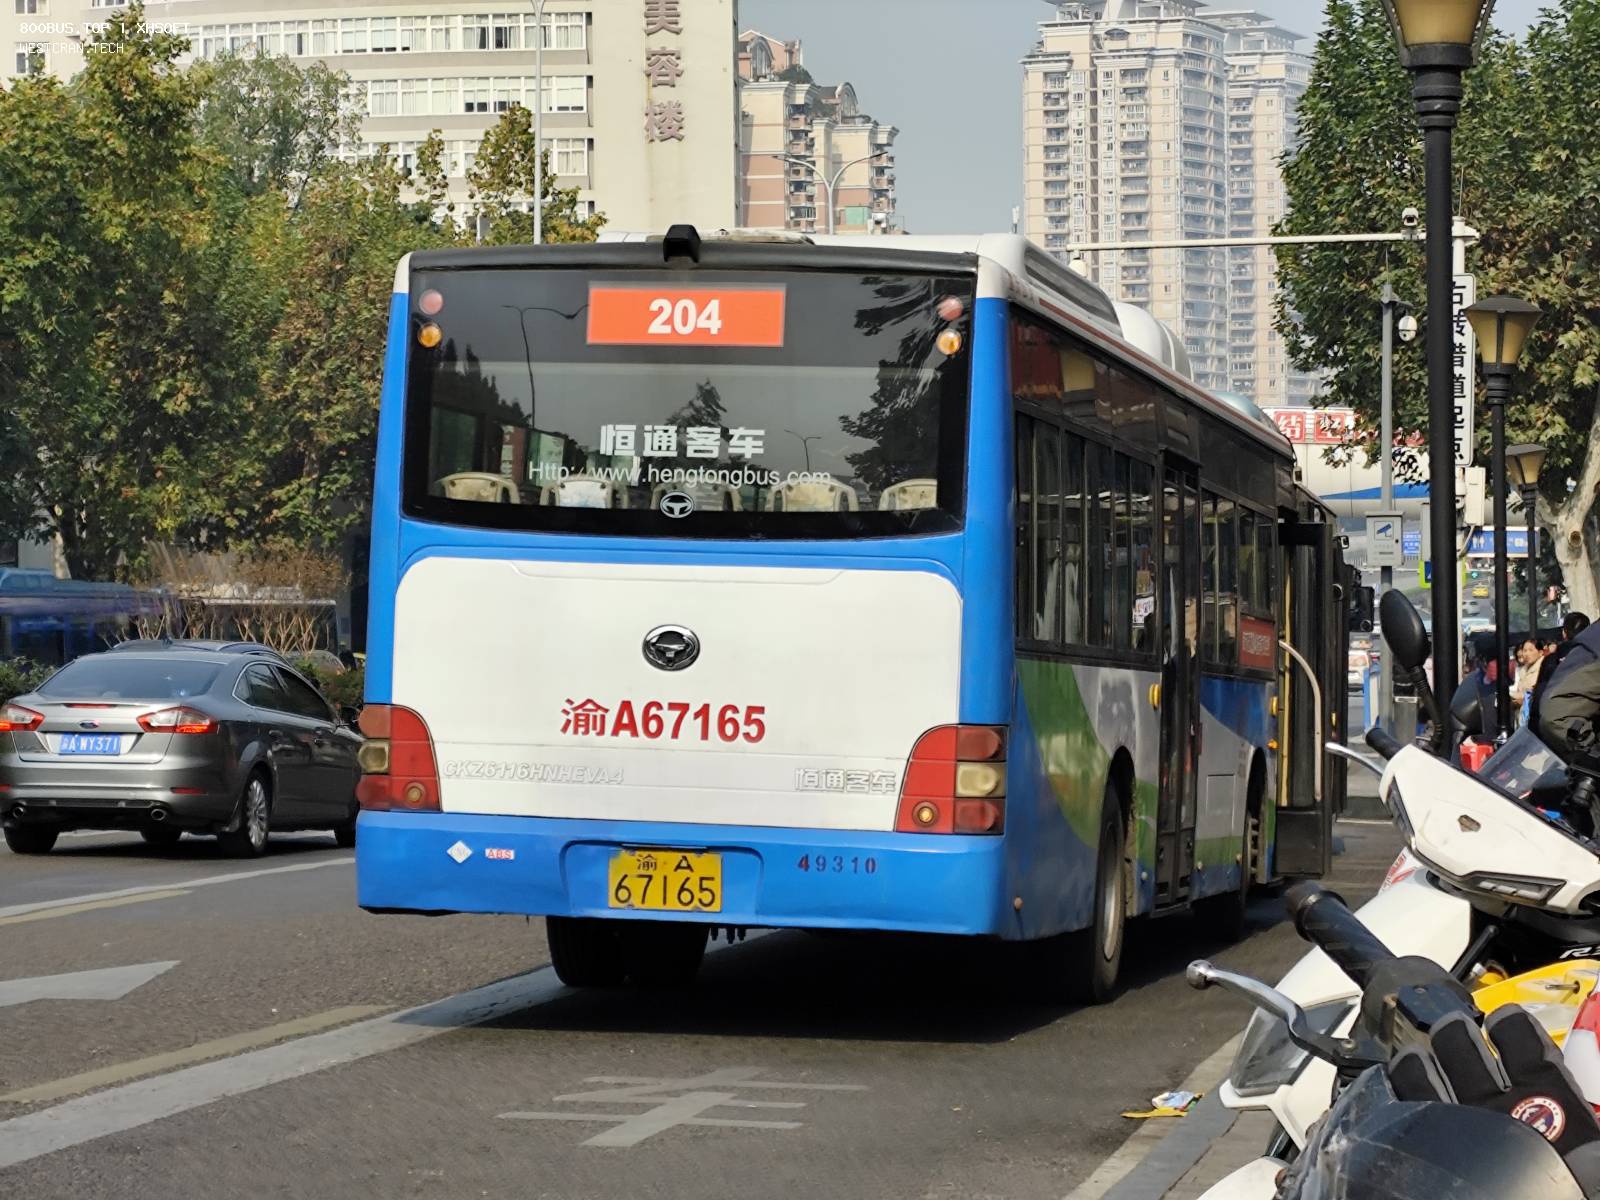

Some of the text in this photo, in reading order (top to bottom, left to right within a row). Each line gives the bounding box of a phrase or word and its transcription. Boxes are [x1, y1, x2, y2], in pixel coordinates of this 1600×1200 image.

[647, 298, 723, 336] 204
[600, 424, 766, 459] 恒通客车
[560, 698, 766, 744] 渝A67165
[443, 760, 625, 785] CKZ6116HNHEVA4
[794, 768, 897, 793] 恒通客车
[487, 848, 513, 860] ABS
[797, 853, 877, 875] 49310
[614, 873, 716, 908] 67165
